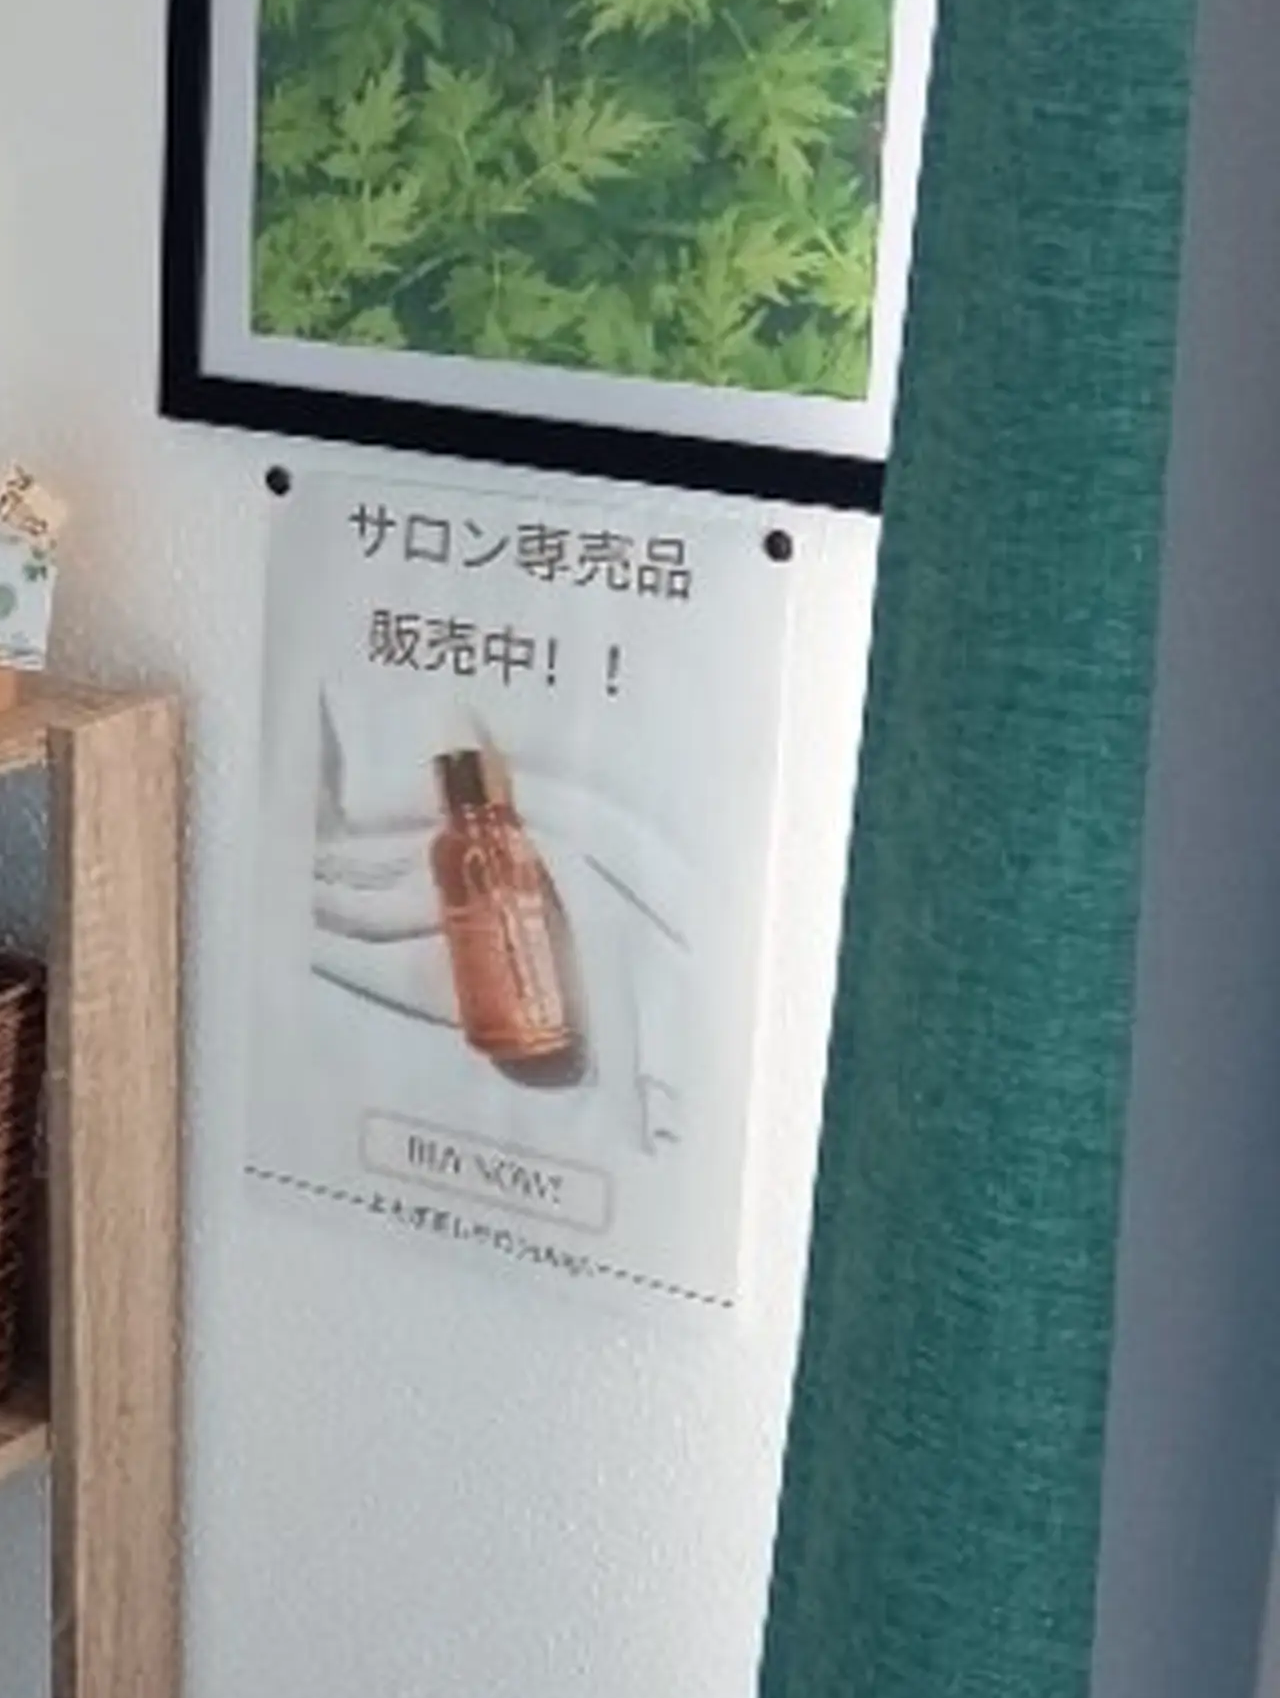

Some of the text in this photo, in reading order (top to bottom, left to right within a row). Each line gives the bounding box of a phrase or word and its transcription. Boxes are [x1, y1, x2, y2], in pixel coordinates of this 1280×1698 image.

[349, 504, 694, 602] サロン専売品
